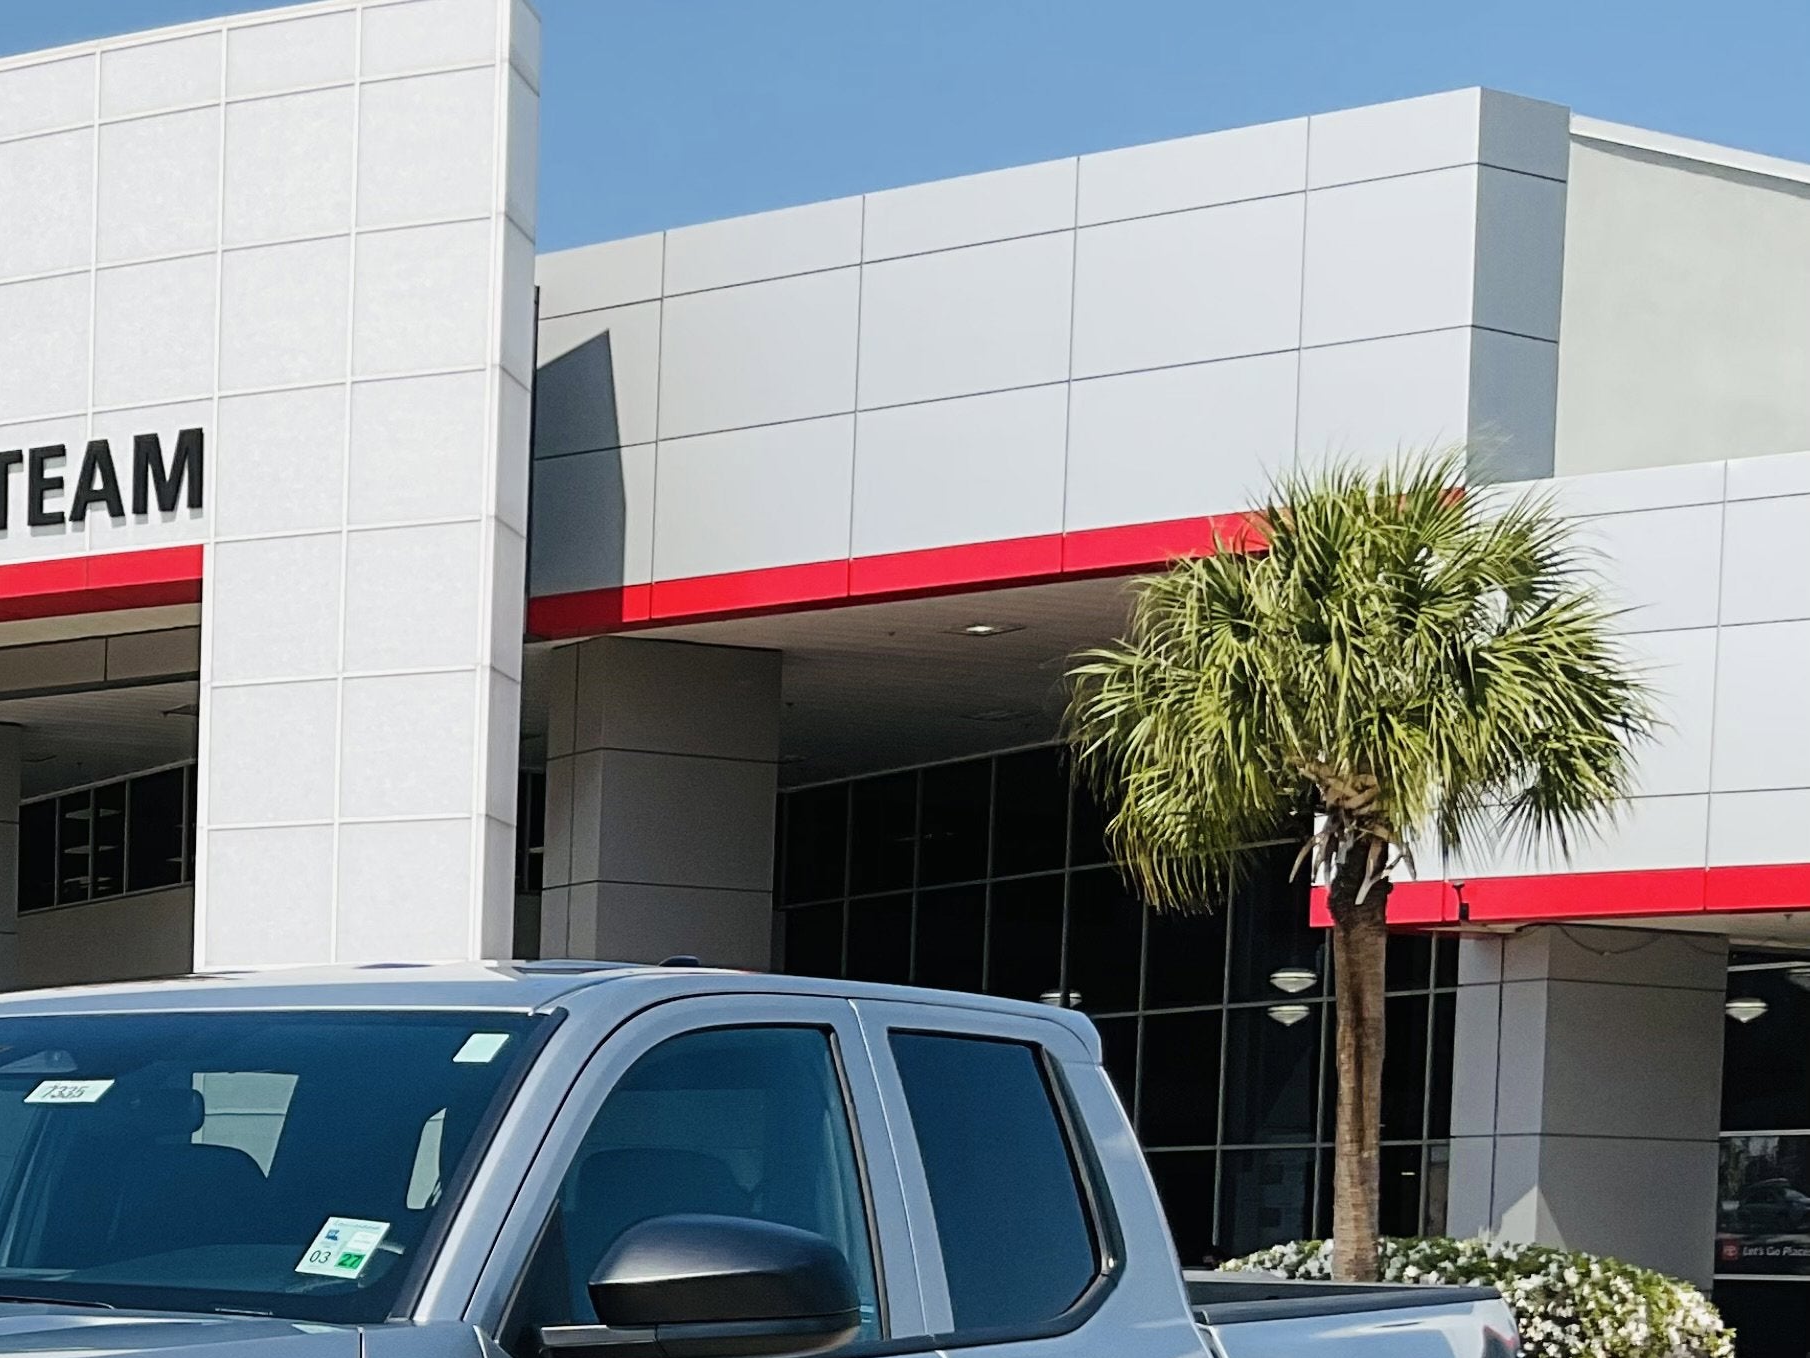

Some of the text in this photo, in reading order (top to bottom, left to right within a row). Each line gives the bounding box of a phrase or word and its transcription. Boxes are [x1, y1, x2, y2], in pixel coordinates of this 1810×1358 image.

[1766, 1246, 1781, 1256] Go
[309, 1250, 366, 1269] 03 27
